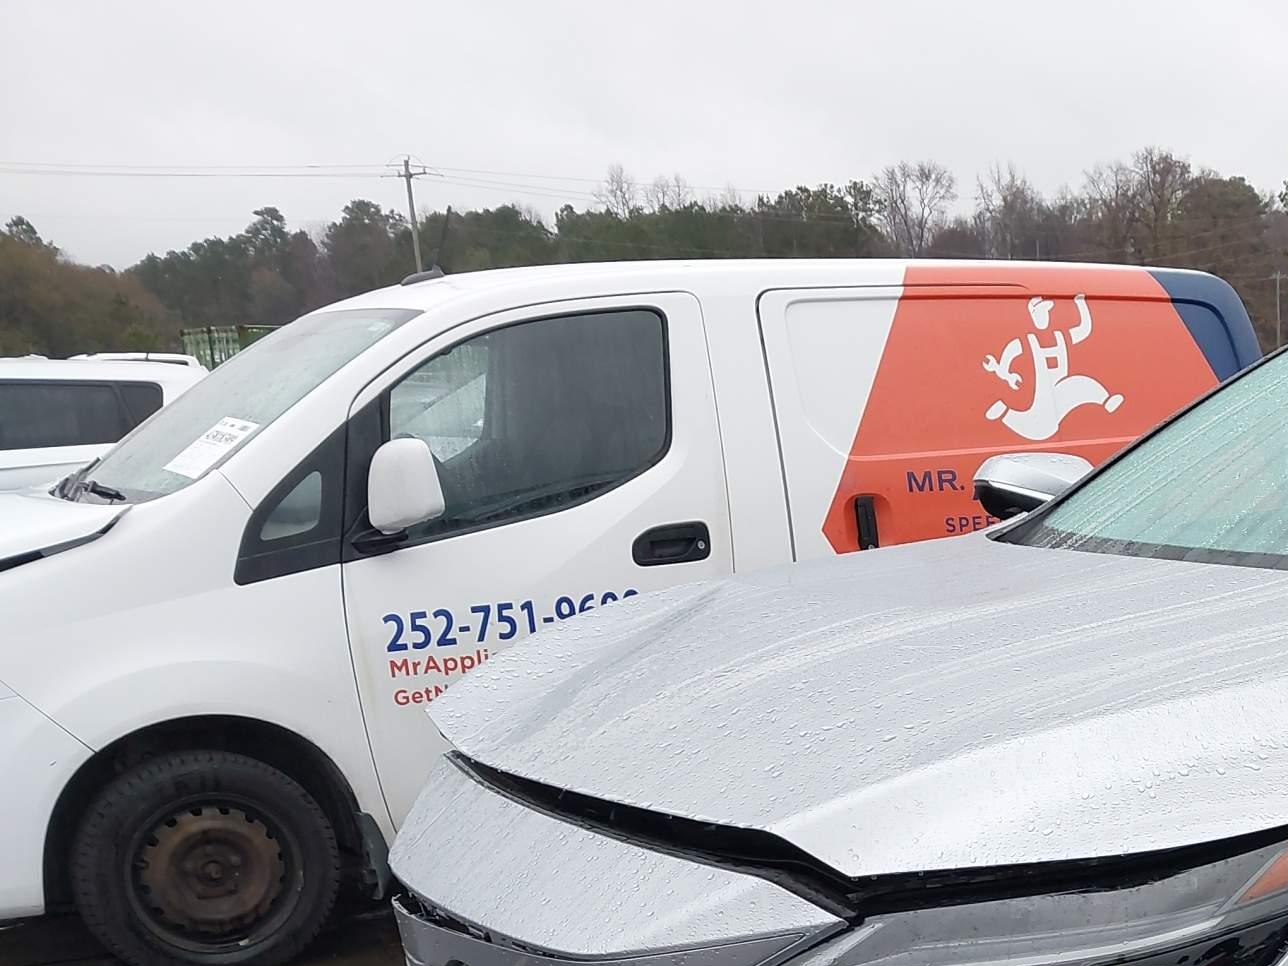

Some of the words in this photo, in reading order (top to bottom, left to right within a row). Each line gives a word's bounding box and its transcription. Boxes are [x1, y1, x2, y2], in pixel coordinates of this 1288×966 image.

[906, 469, 965, 492] MR.
[382, 588, 639, 653] 252-751-96
[389, 648, 498, 678] MrAppli
